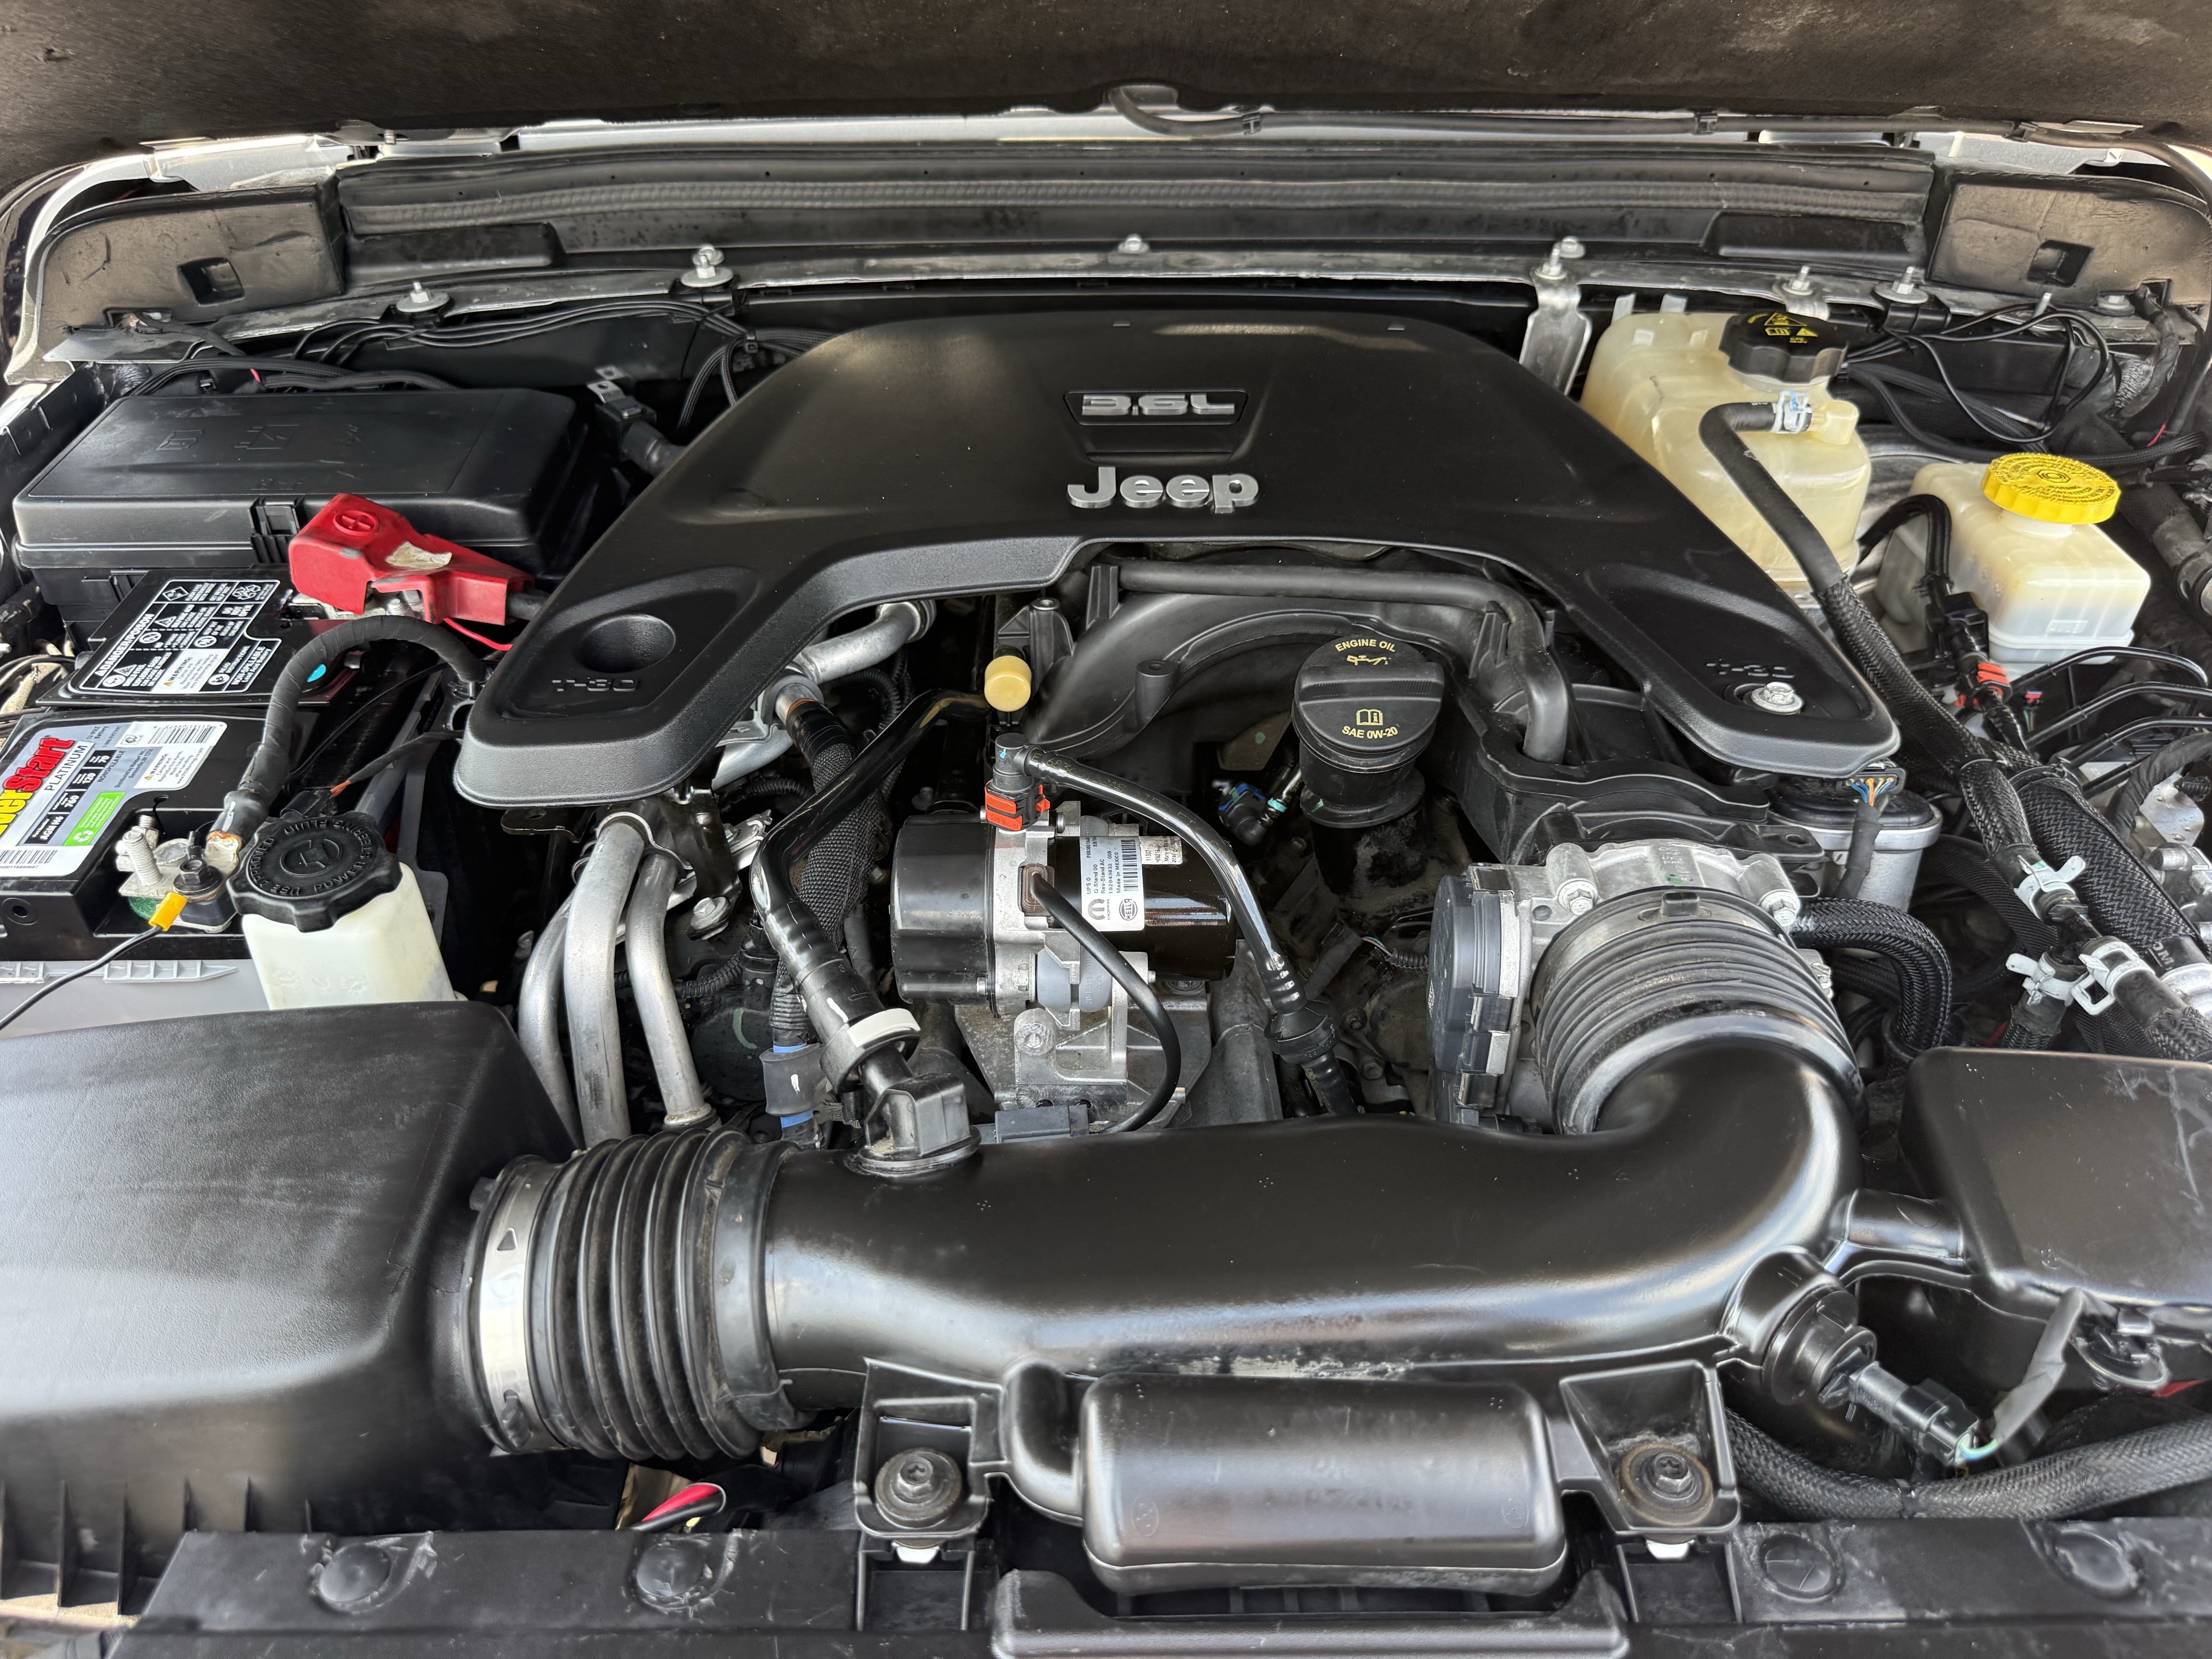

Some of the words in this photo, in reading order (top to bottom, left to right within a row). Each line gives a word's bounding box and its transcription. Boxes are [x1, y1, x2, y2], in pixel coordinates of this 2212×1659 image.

[1082, 393, 1235, 416] 3.6L
[1067, 466, 1259, 514] Jeep
[229, 606, 244, 615] NOT
[100, 614, 156, 669] DANGER/POISON
[1335, 639, 1376, 652] ENGINE
[1379, 641, 1396, 652] OIL
[167, 657, 193, 681] WARNING:
[230, 646, 266, 685] NON-SPILLABLE
[1342, 726, 1364, 738] SAE
[1367, 727, 1398, 739] 0W-20
[43, 745, 88, 791] PLATINUM
[95, 750, 126, 782] NONSPILLABLE
[97, 755, 111, 763] 70
[149, 753, 169, 774] WARNING:
[0, 737, 76, 836] verStart
[81, 773, 97, 784] 120
[63, 795, 81, 807] 760
[38, 825, 58, 840] AGM
[50, 816, 65, 824] H6
[284, 819, 329, 835] FLUID
[333, 819, 372, 858] STEERING
[250, 838, 274, 888] APPROVED
[314, 861, 365, 893] POWER
[271, 884, 301, 896] USE
